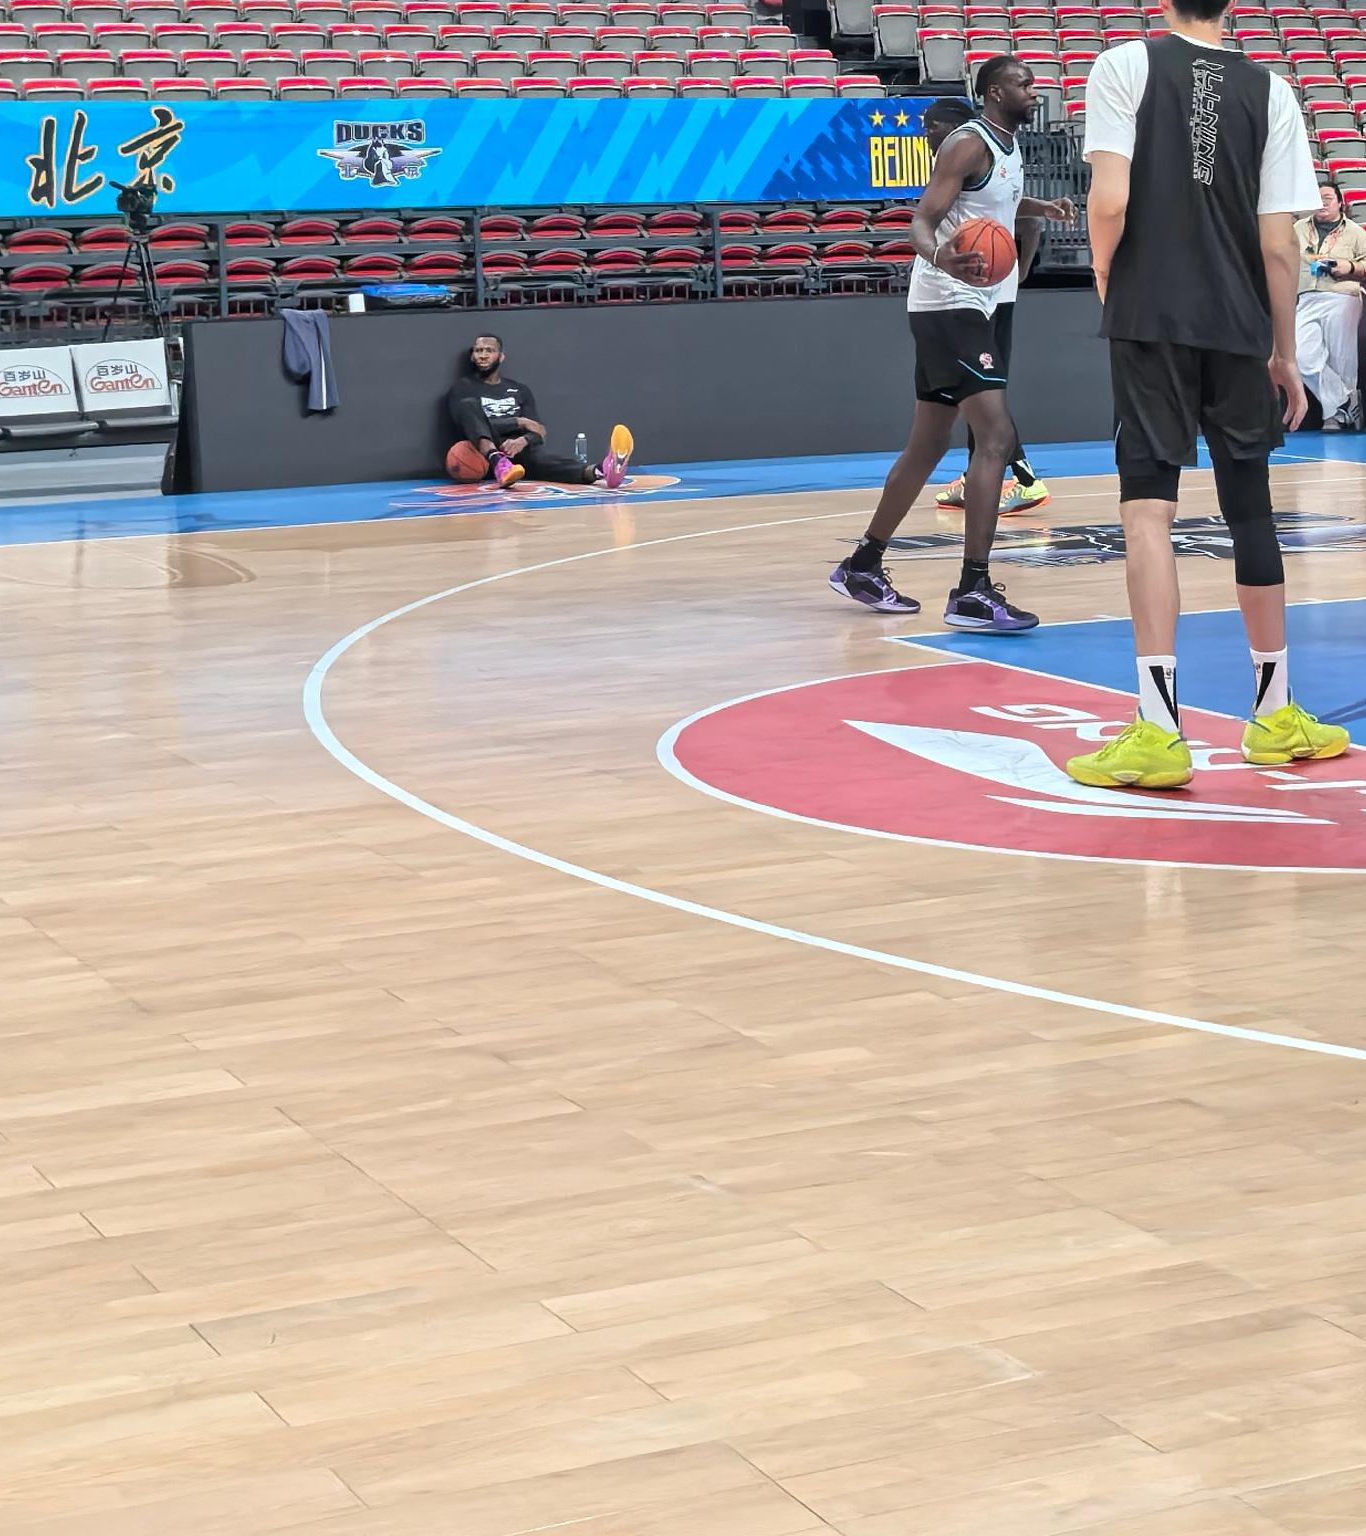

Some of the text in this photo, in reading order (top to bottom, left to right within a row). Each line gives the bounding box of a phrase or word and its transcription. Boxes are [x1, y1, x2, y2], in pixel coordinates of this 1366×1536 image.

[336, 121, 423, 144] DUCKS
[1197, 71, 1224, 186] LI-NING
[26, 106, 184, 208] 北京
[4, 369, 46, 382] 百岁山
[96, 363, 138, 377] 百岁山
